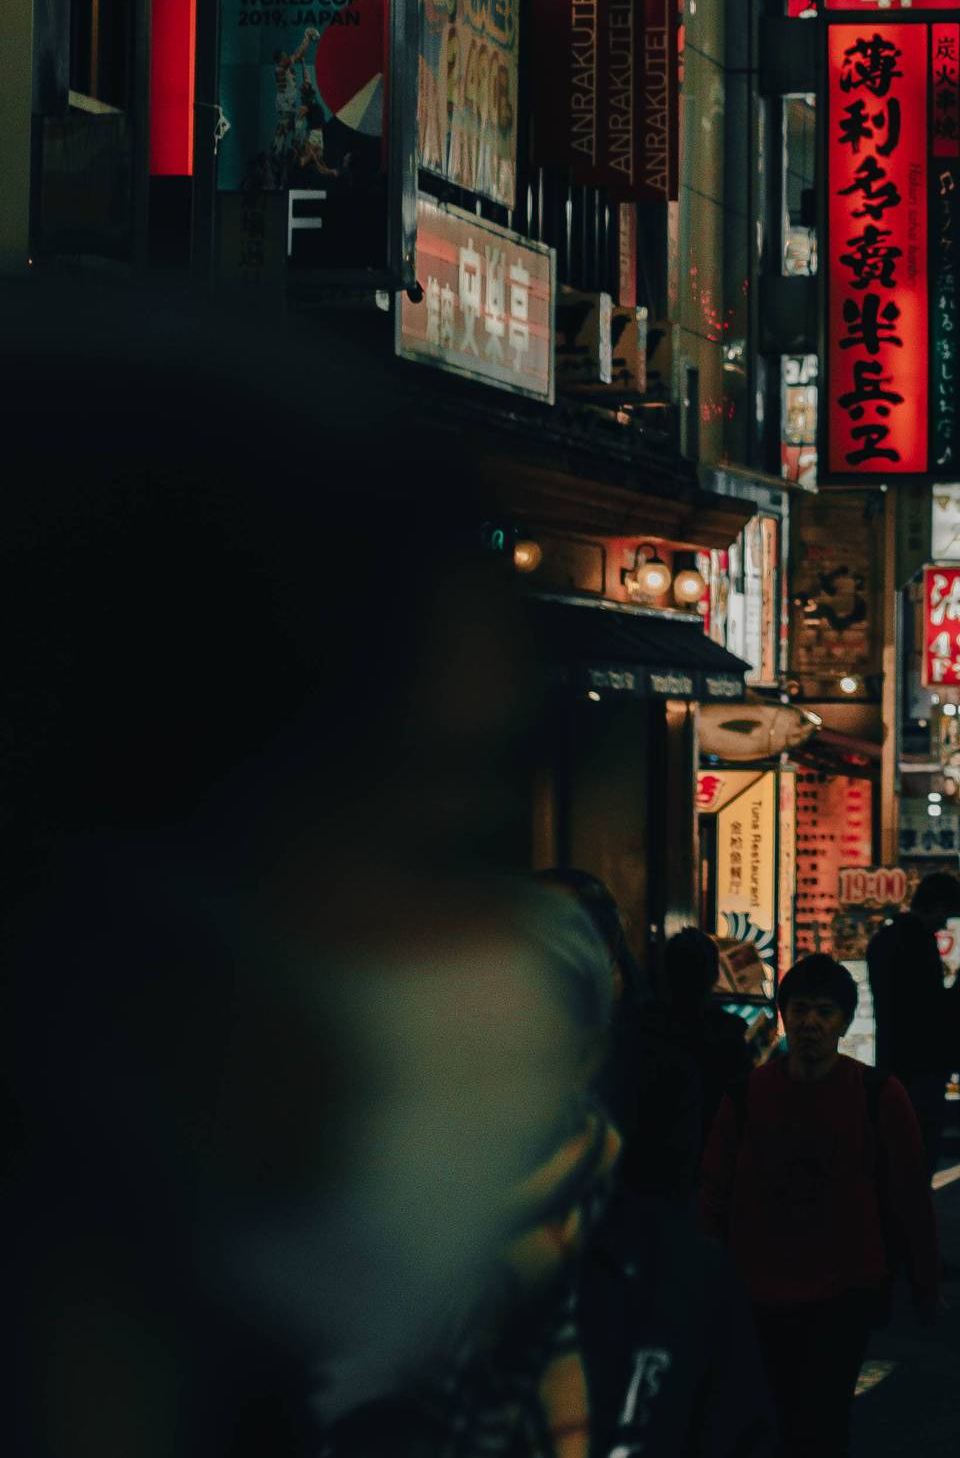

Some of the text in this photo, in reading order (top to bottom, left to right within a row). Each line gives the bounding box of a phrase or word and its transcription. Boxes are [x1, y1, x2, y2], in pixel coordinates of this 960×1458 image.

[291, 9, 361, 27] JAPAN
[607, 4, 632, 176] ANRAKUTEI
[643, 26, 669, 193] ANRAKUTEI
[841, 869, 907, 903] 19:00
